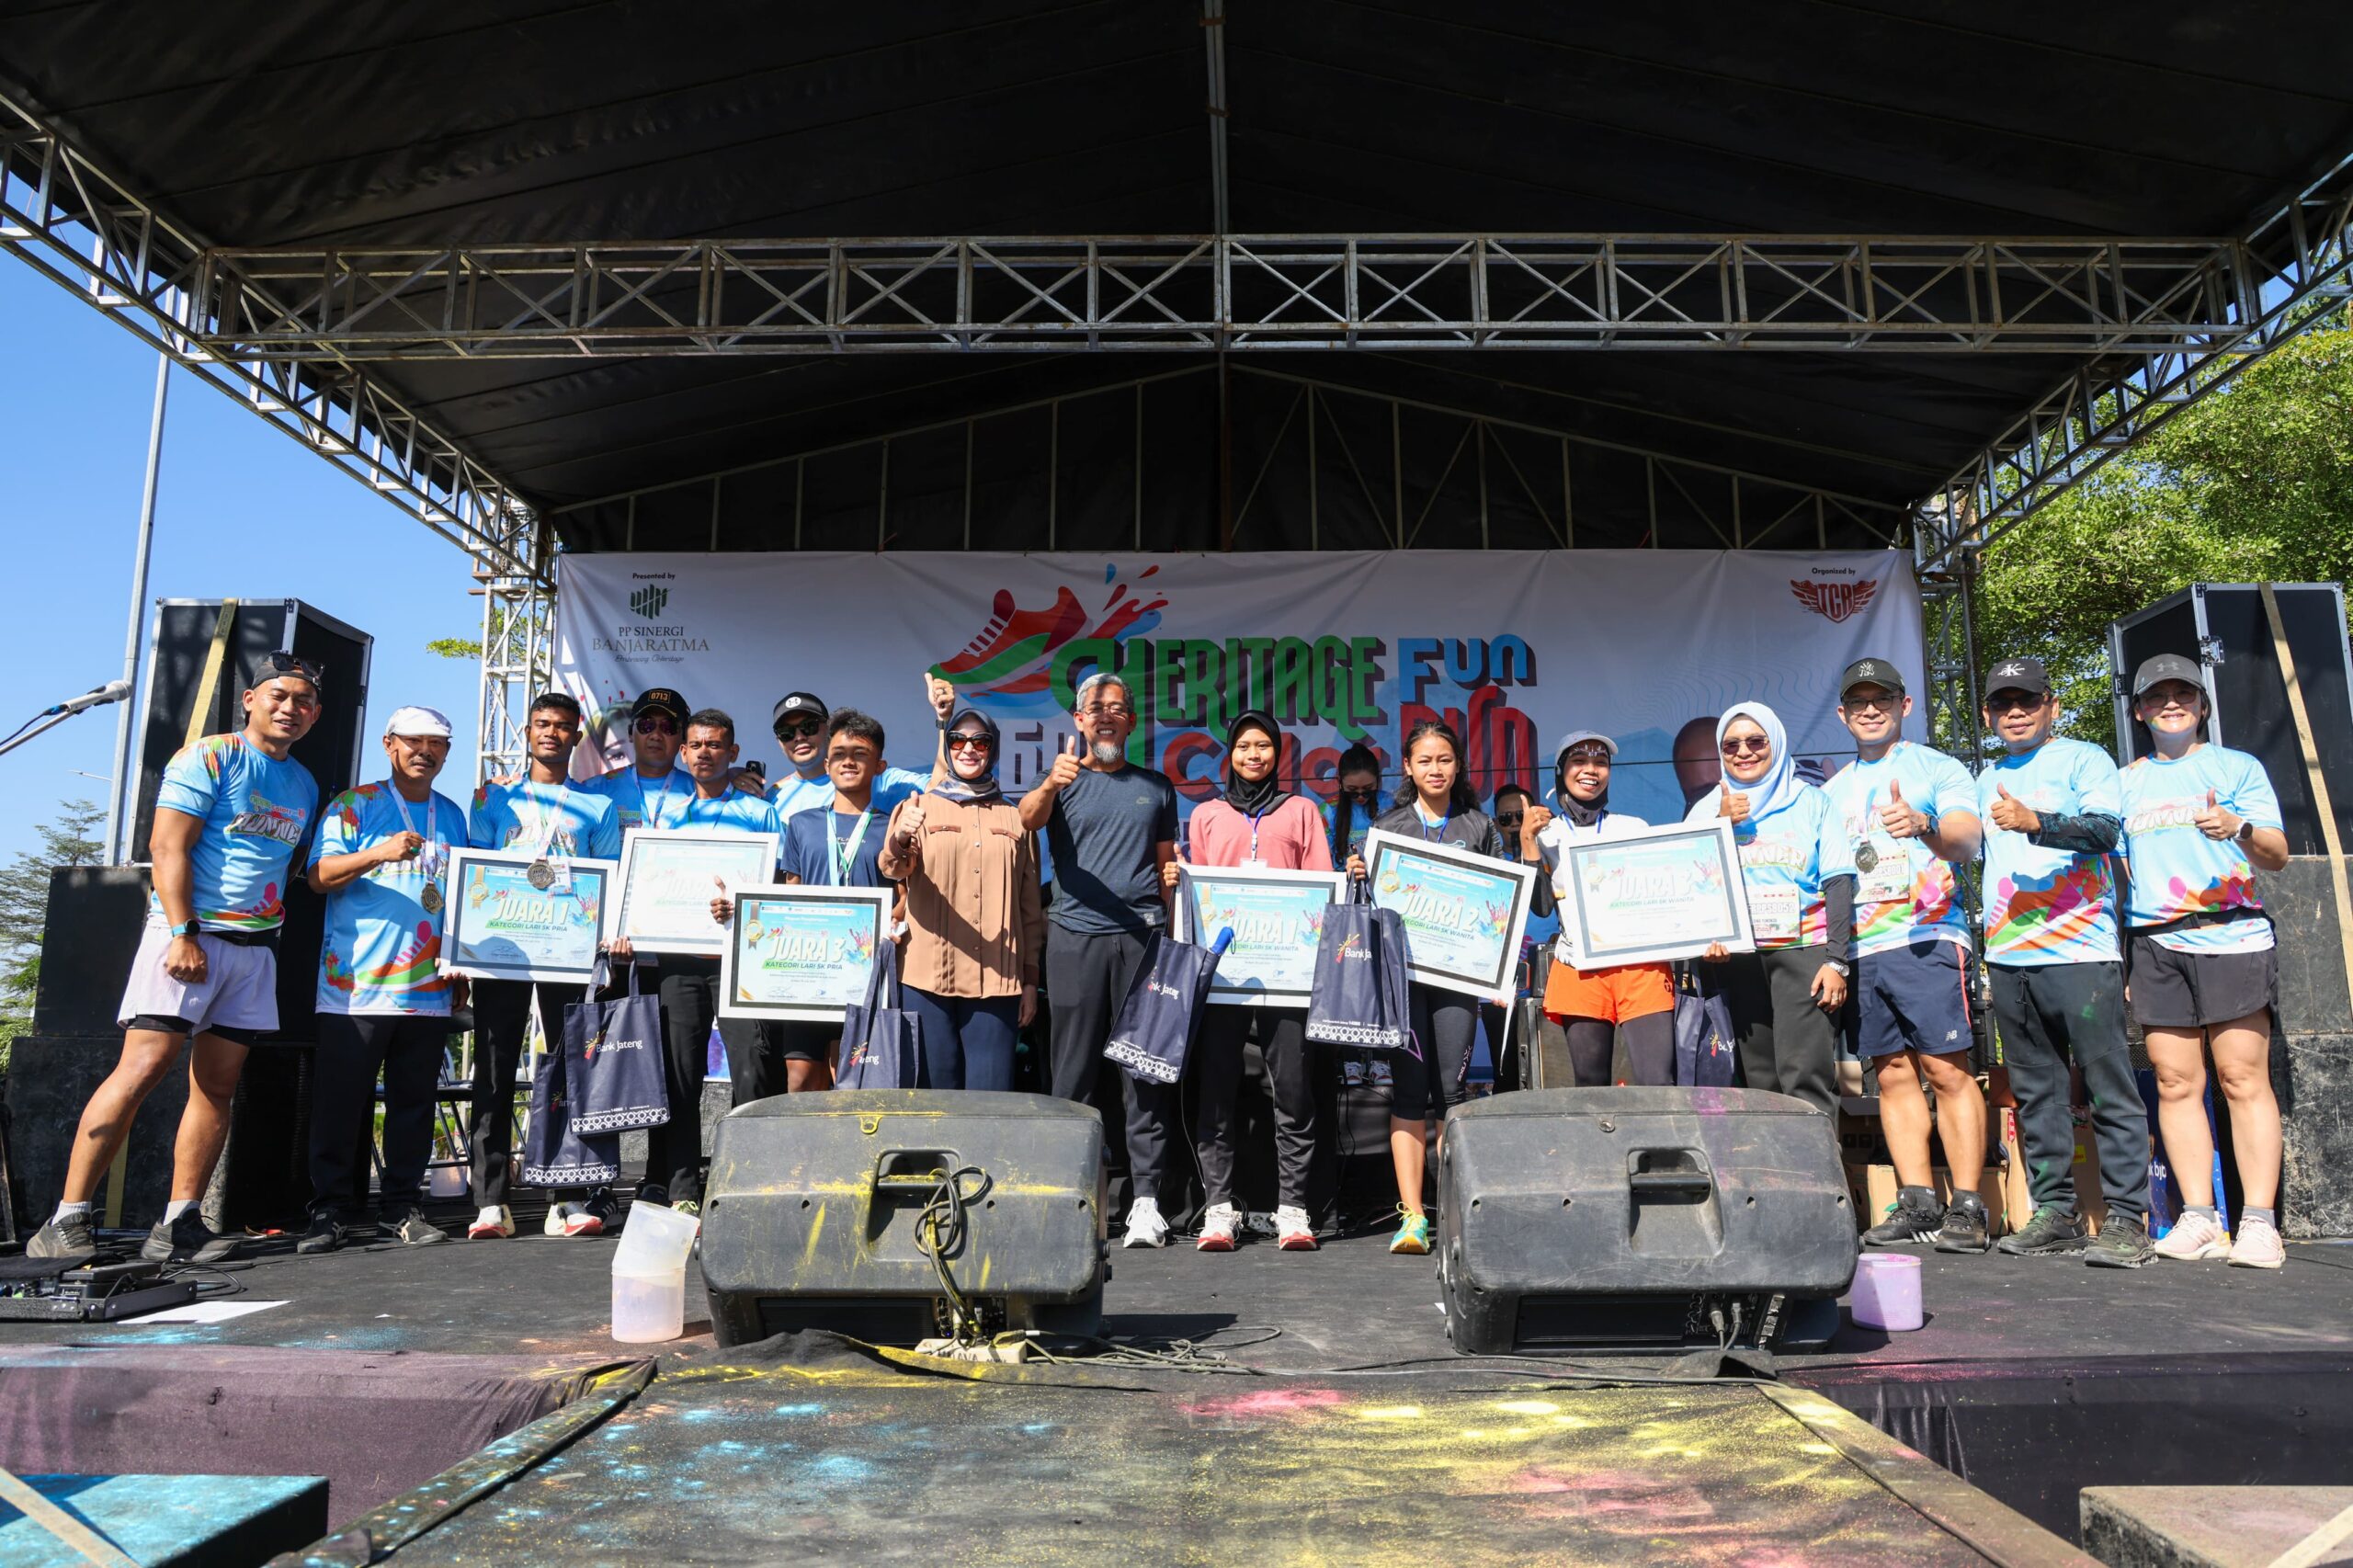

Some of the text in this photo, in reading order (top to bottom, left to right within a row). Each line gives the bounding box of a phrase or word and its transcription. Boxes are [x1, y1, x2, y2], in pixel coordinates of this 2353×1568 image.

[667, 573, 676, 581] by
[1812, 567, 1857, 576] Organized by
[619, 626, 684, 637] PP SINERGI
[593, 638, 710, 653] BANJARATMA
[650, 692, 669, 701] 0713
[492, 896, 571, 926] JUARA 1
[1400, 891, 1480, 933] JUARA 2
[489, 921, 524, 929] KATEGORI
[1289, 918, 1299, 945] 1
[1426, 923, 1440, 932] LARI
[1450, 929, 1475, 941] WANITA
[767, 934, 847, 962] JUARA 3
[1345, 947, 1366, 959] Bank
[765, 960, 800, 970] KATEGORI
[597, 1040, 643, 1053] Bank Jateng
